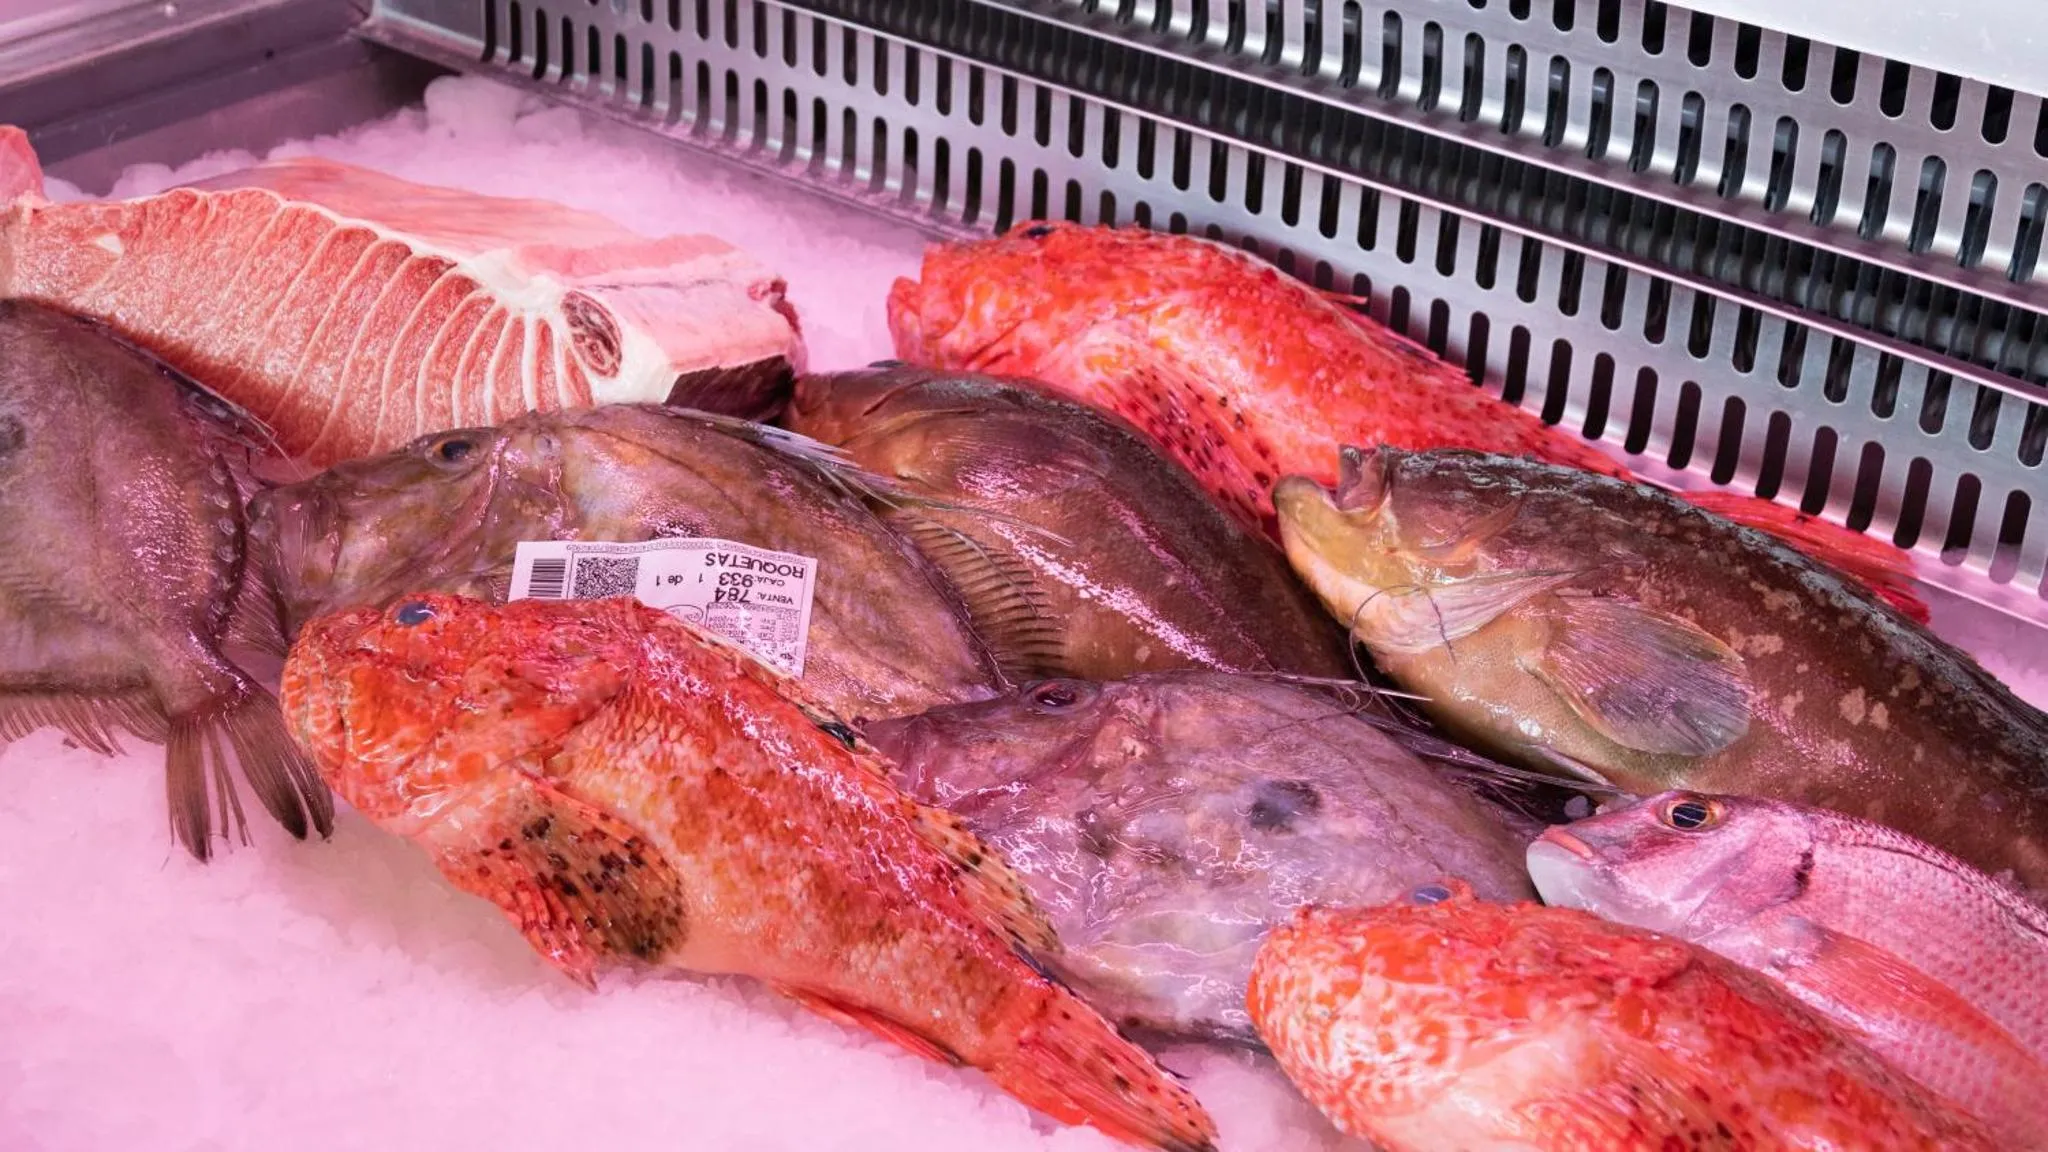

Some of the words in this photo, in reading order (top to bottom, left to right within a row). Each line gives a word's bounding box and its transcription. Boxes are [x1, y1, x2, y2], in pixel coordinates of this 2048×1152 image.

[705, 552, 804, 579] ROQUETAS
[655, 575, 660, 587] 1
[667, 574, 683, 586] de
[719, 572, 754, 588] 933
[714, 587, 751, 603] 784
